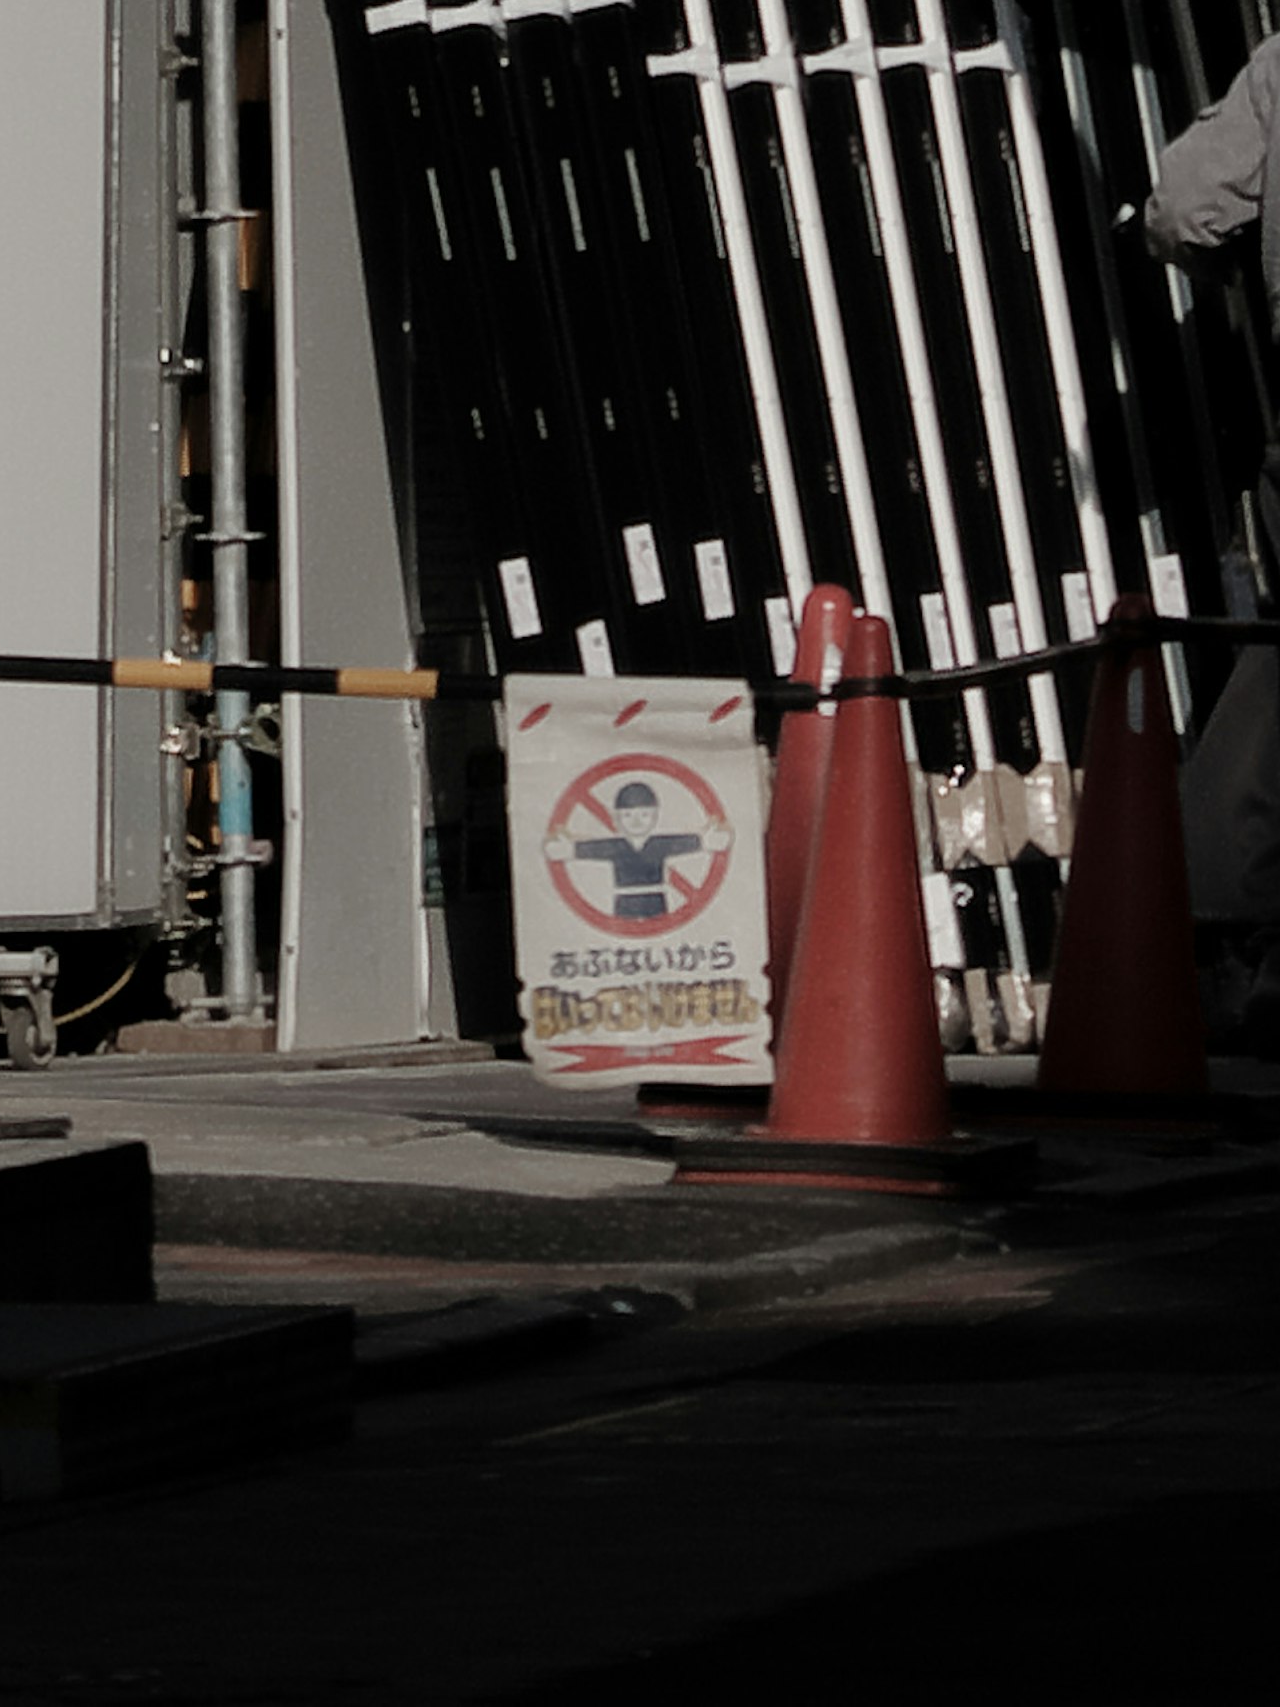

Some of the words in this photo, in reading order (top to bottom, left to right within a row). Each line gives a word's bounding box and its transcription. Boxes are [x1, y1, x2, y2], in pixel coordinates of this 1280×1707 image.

[549, 941, 736, 979] あぶないから
